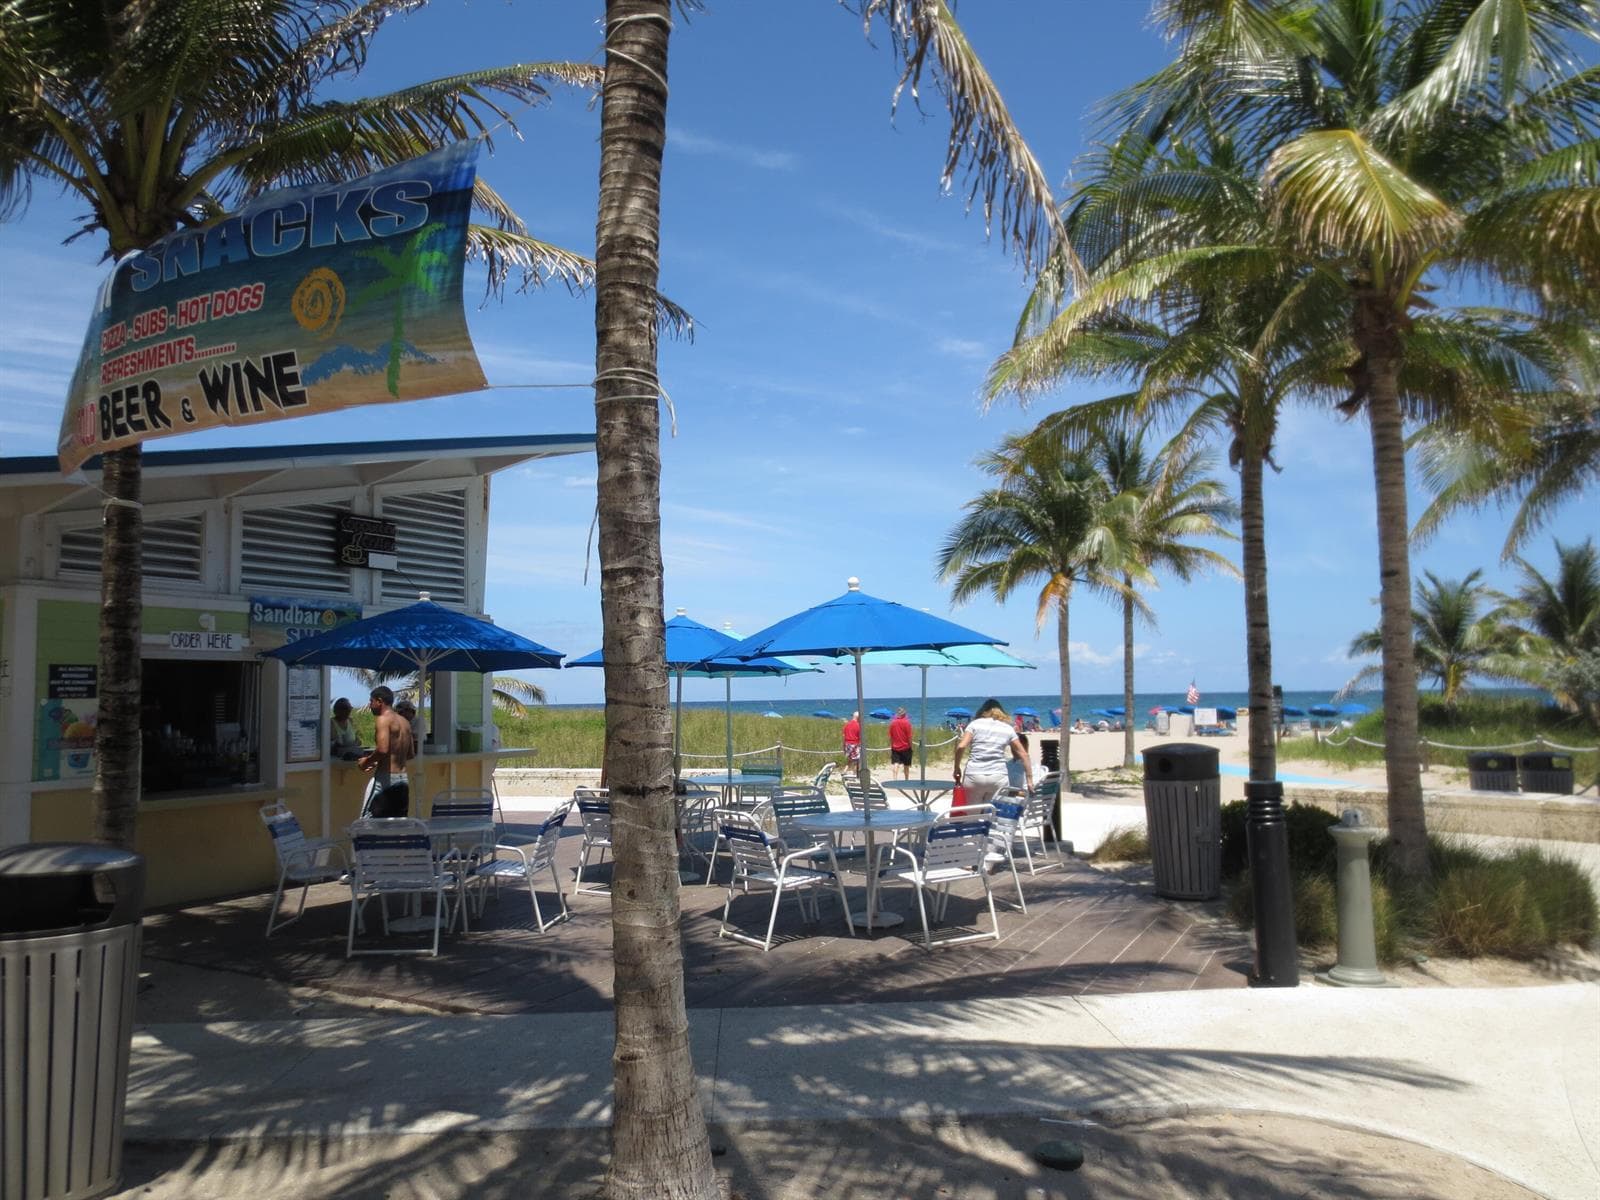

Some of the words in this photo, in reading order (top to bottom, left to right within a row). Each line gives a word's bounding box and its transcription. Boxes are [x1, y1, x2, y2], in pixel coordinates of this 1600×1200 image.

[131, 180, 433, 293] SNACKS
[101, 321, 127, 355] PIZZA
[133, 306, 168, 342] SUBS
[177, 294, 211, 330] HOT
[211, 283, 265, 320] DOGS
[99, 378, 172, 442] BEER
[180, 396, 198, 424] &
[198, 350, 309, 417] WINE
[171, 633, 202, 648] ORDER
[207, 634, 233, 649] HERE
[253, 603, 321, 625] Sandbar
